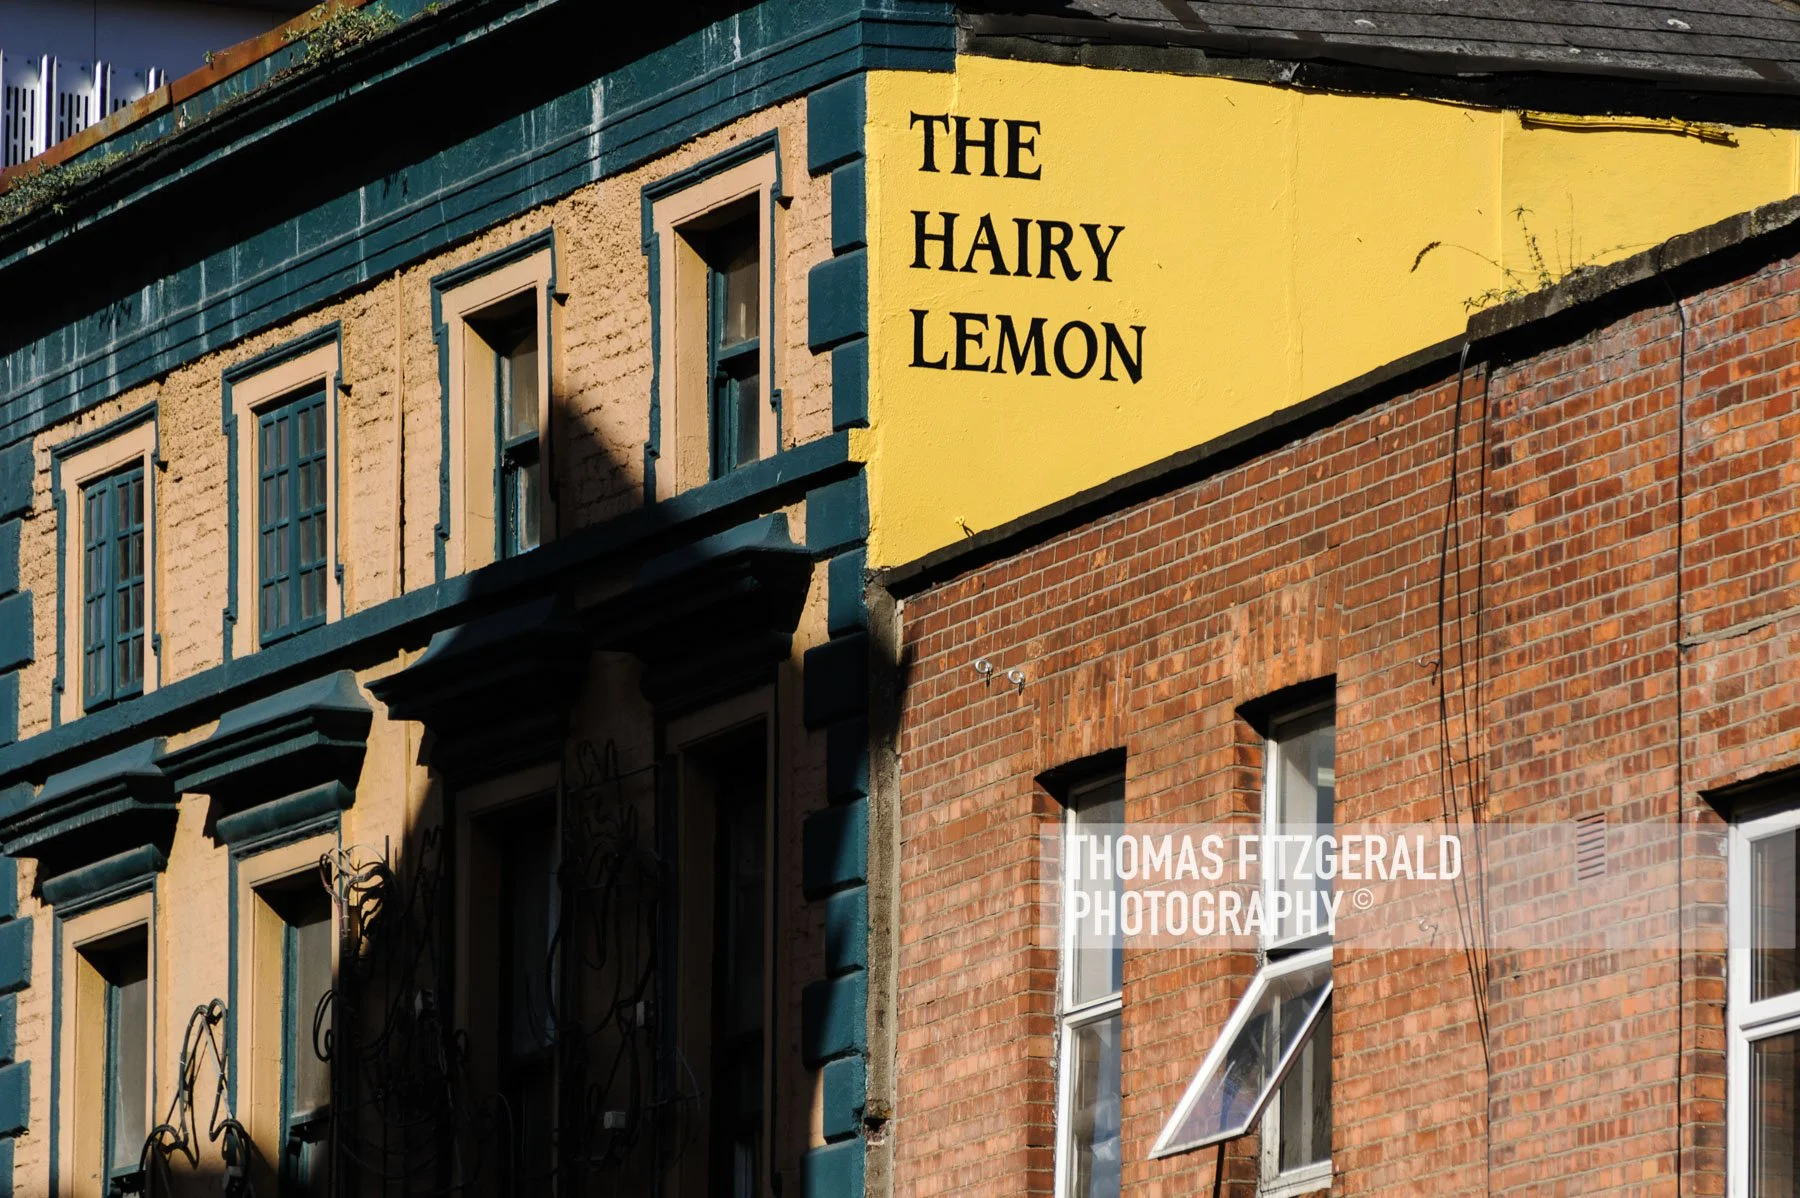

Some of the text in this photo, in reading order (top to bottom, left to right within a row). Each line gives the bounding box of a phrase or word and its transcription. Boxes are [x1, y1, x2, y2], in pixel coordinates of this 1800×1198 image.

[910, 111, 1042, 181] THE
[909, 210, 1126, 283] HAIRY
[909, 309, 1147, 385] LEMON
